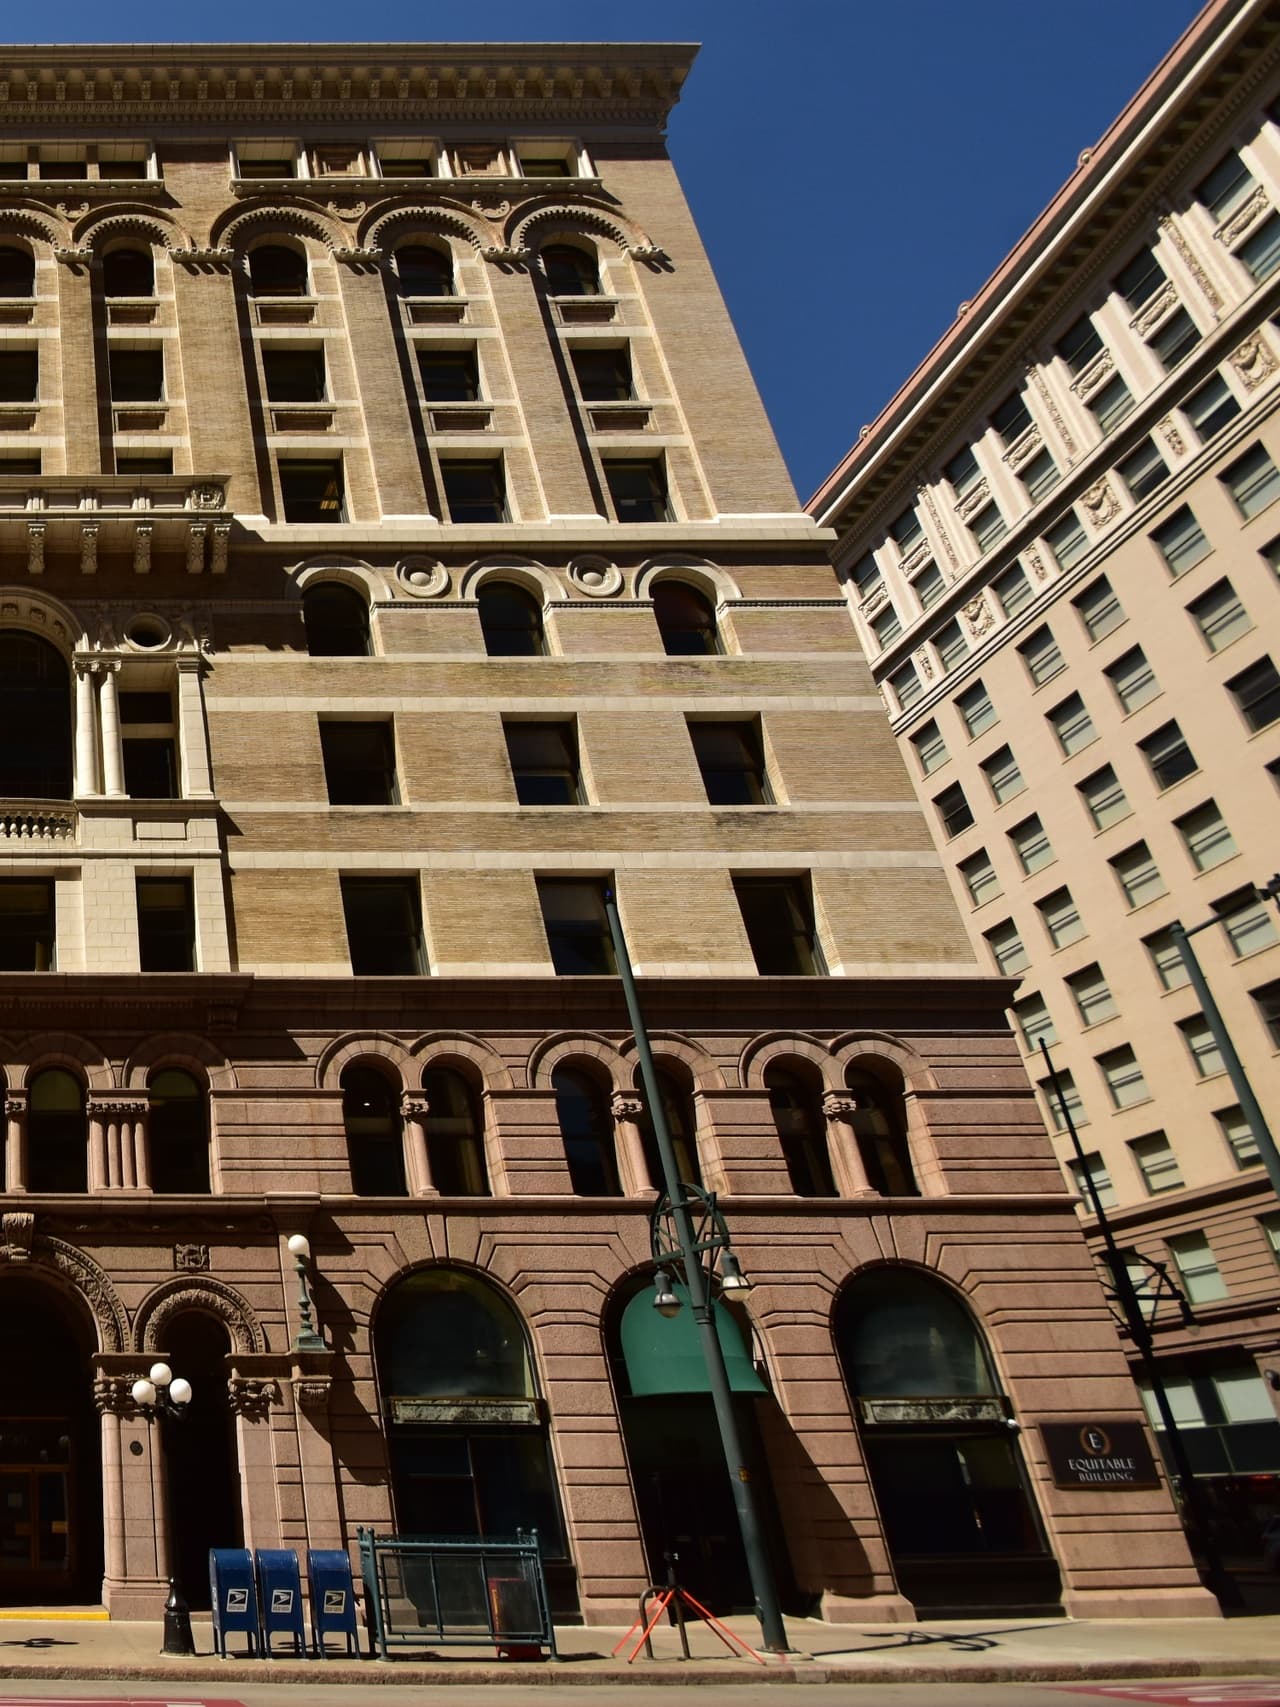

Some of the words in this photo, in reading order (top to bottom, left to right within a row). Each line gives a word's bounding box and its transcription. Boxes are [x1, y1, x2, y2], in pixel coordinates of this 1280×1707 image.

[1088, 1433, 1102, 1448] E
[1068, 1458, 1135, 1472] EQUITABLE
[1078, 1471, 1134, 1481] BUILDING
